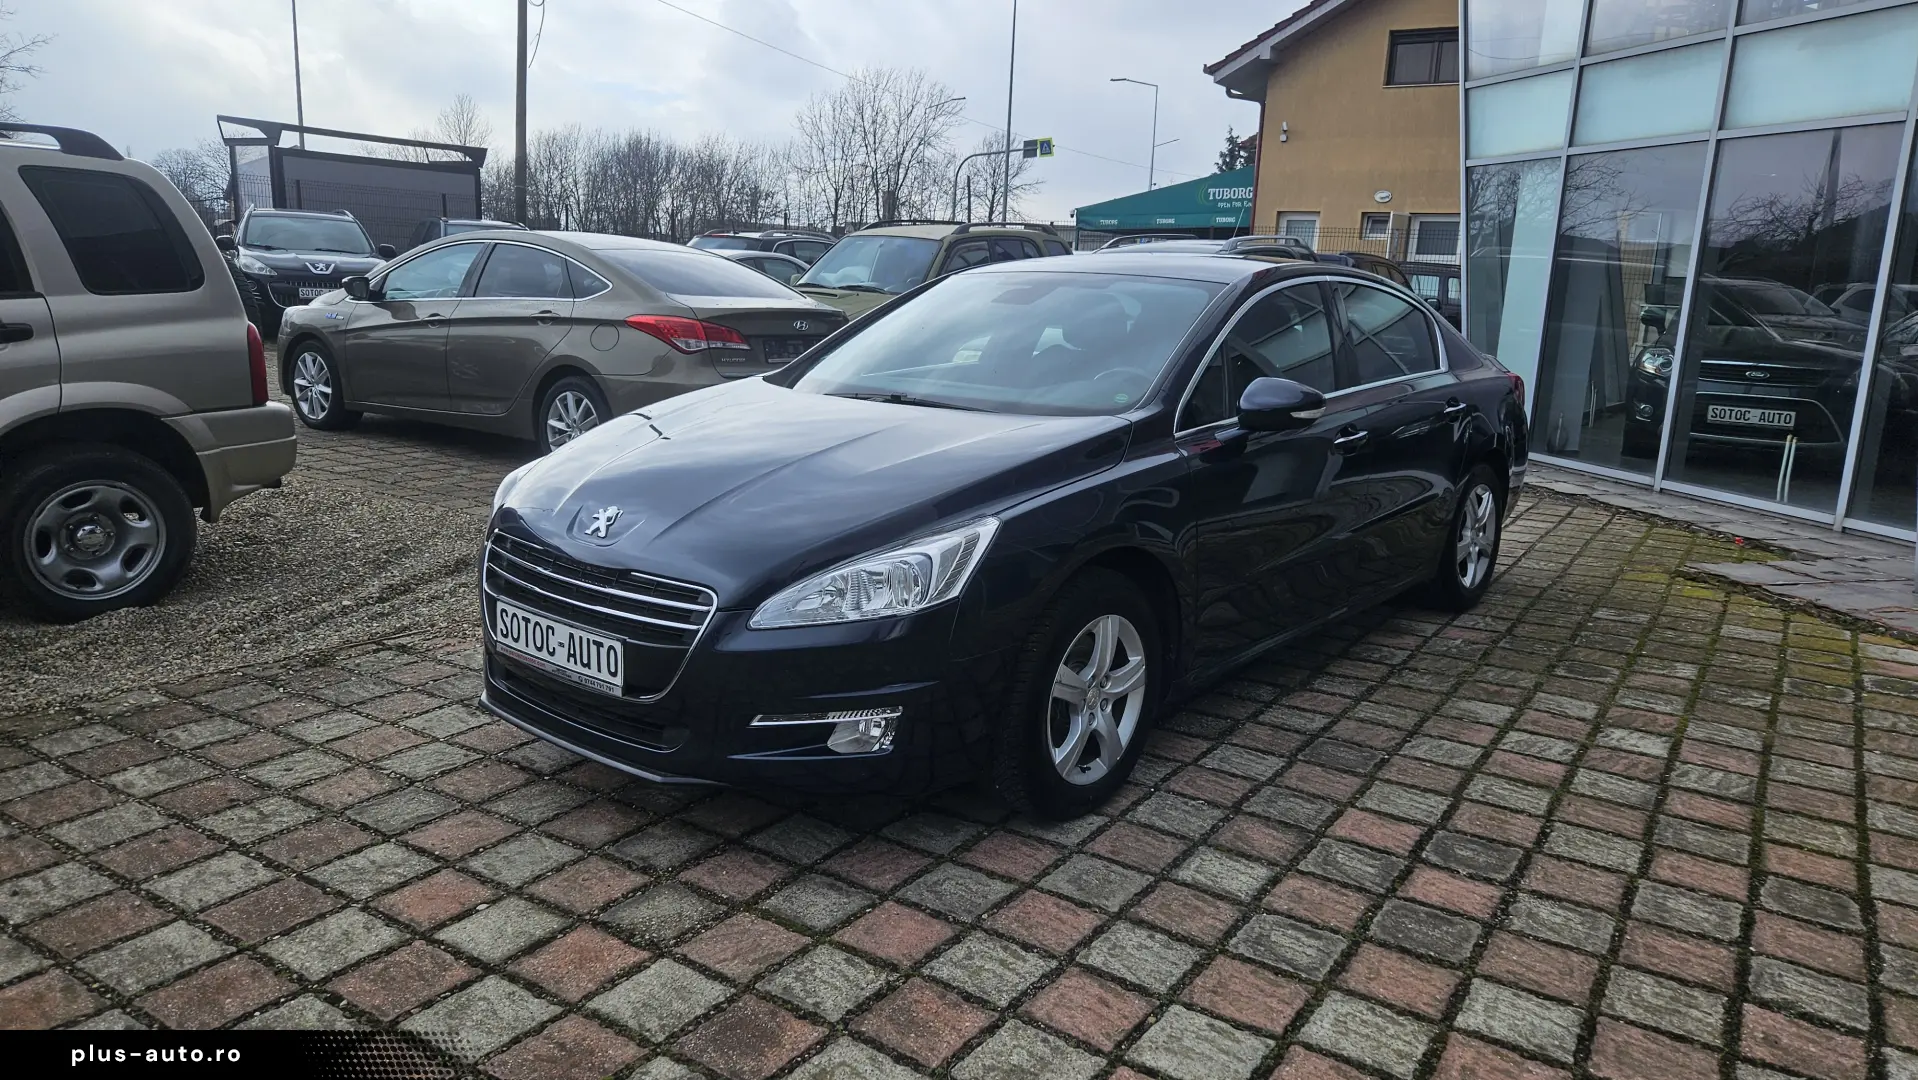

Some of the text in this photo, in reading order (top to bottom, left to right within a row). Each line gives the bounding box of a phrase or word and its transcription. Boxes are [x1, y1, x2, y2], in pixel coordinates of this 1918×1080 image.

[1207, 187, 1253, 200] TUBORG
[1710, 407, 1792, 425] SOTOC-AUTO
[500, 607, 618, 678] SOTOC-AUTO
